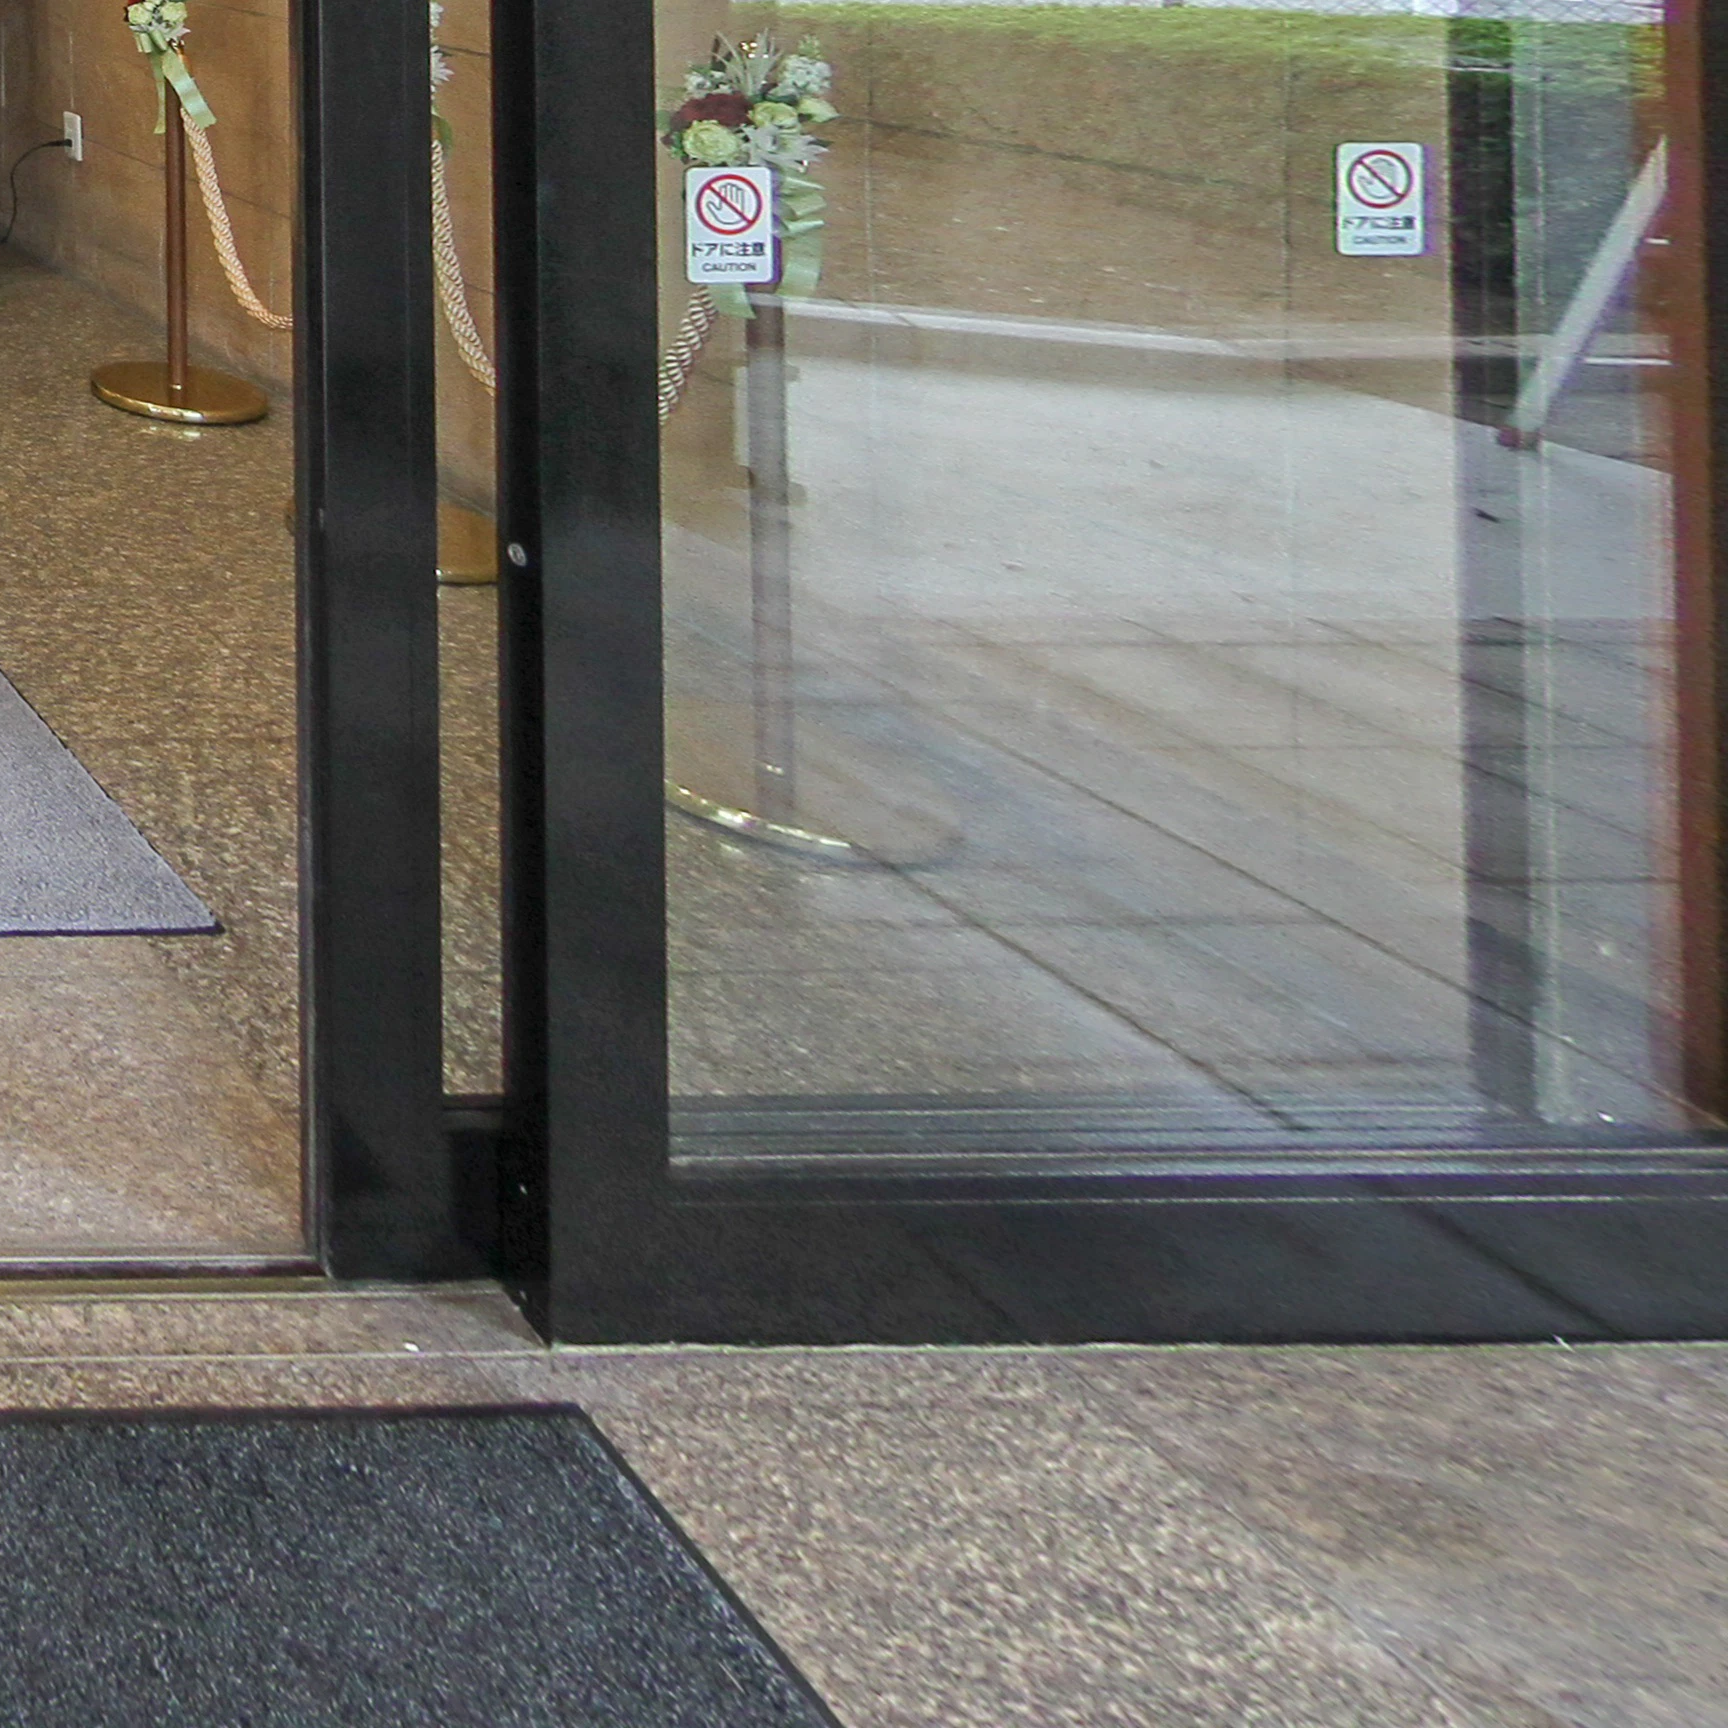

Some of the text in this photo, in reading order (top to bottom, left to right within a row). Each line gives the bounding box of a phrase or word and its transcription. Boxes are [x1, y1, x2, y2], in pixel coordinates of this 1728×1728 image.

[691, 242, 766, 257] ドアに注意
[701, 262, 758, 272] CAUTION
